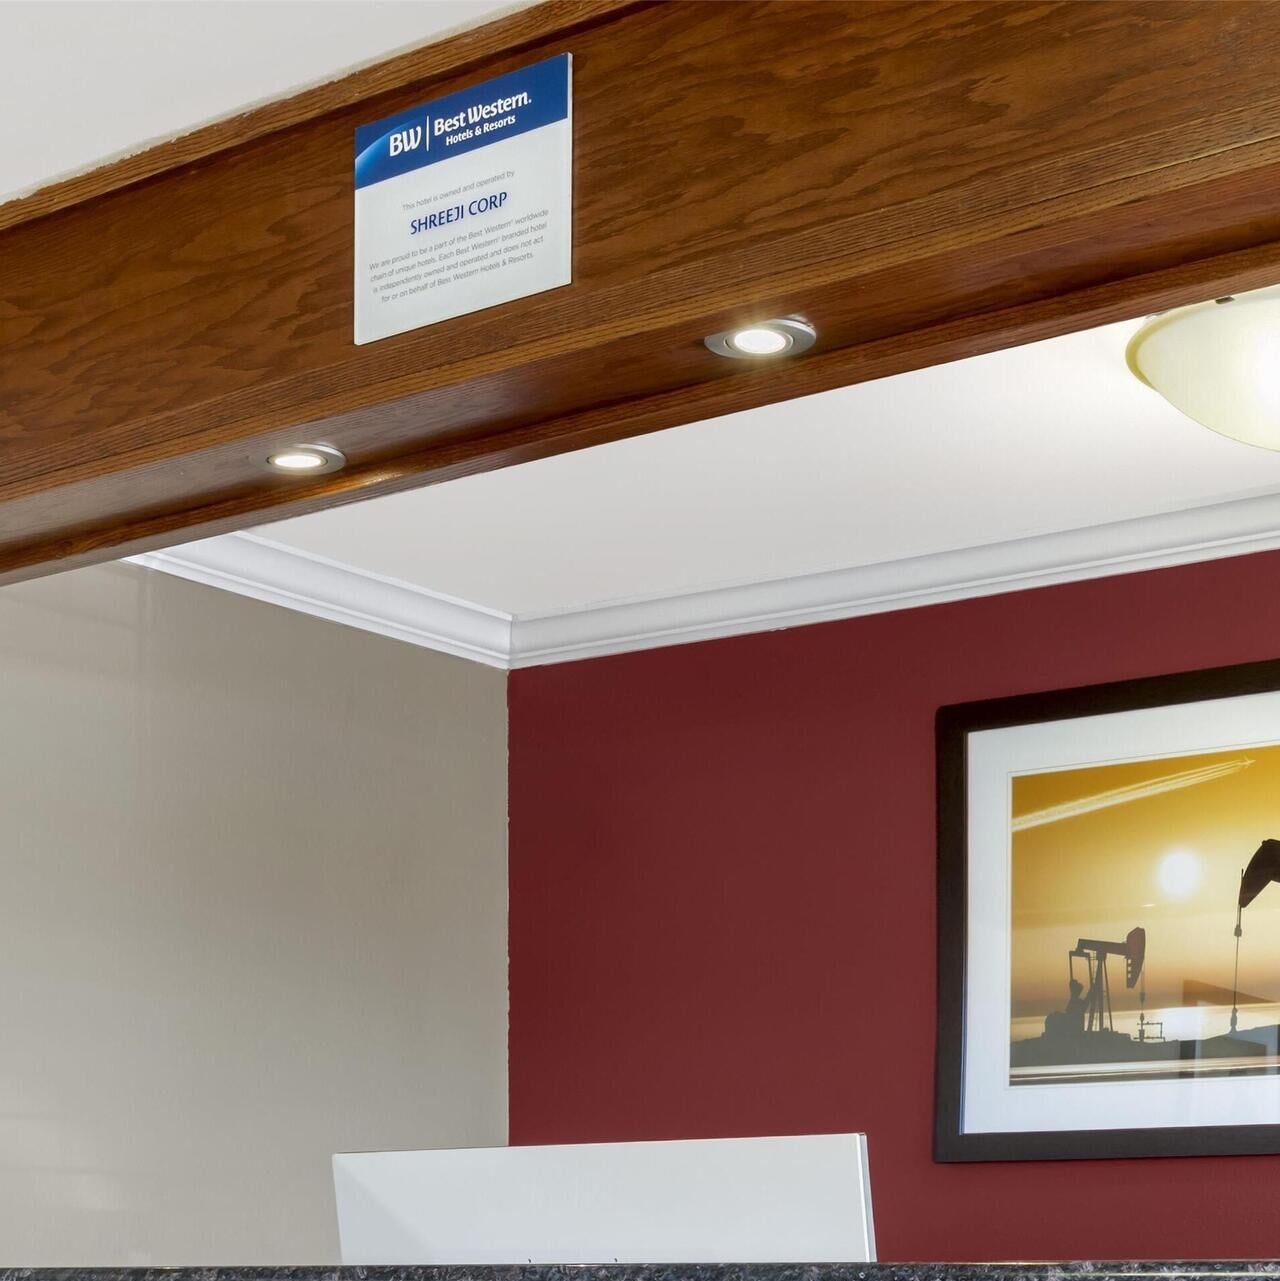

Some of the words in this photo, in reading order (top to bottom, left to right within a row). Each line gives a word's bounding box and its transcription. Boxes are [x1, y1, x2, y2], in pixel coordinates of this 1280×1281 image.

[389, 126, 421, 157] BW
[434, 112, 466, 136] Best
[446, 128, 473, 146] Hotels
[475, 126, 482, 136] &
[483, 115, 516, 133] Resorts
[402, 203, 415, 211] This
[416, 197, 432, 206] hotel
[439, 187, 461, 200] owned
[462, 183, 475, 192] and
[475, 173, 506, 188] operated
[506, 170, 515, 178] by
[410, 204, 464, 235] SHREEJI
[468, 191, 507, 215] CORP
[369, 263, 379, 271] We
[381, 259, 391, 267] are
[391, 253, 410, 264] proud
[419, 247, 428, 255] be
[434, 240, 448, 251] part
[449, 237, 456, 246] of
[456, 234, 467, 243] the
[468, 230, 483, 240] Best
[514, 209, 549, 225] worldwide
[370, 272, 386, 282] chain
[387, 269, 395, 277] of
[395, 264, 416, 274] unique
[438, 251, 454, 261] Each
[455, 246, 470, 256] Best
[501, 227, 529, 241] branded
[530, 221, 548, 232] hotel
[379, 273, 422, 291] independently
[423, 265, 445, 278] owned
[446, 261, 458, 271] and
[459, 252, 489, 268] operated
[489, 248, 502, 258] and
[503, 244, 519, 254] does
[520, 240, 532, 249] not
[532, 235, 544, 245] act
[381, 295, 390, 303] for
[399, 289, 408, 298] on
[408, 282, 429, 295] behalf
[429, 280, 436, 288] of
[437, 277, 451, 286] Best
[453, 267, 479, 281] Western
[480, 262, 501, 272] Hotels
